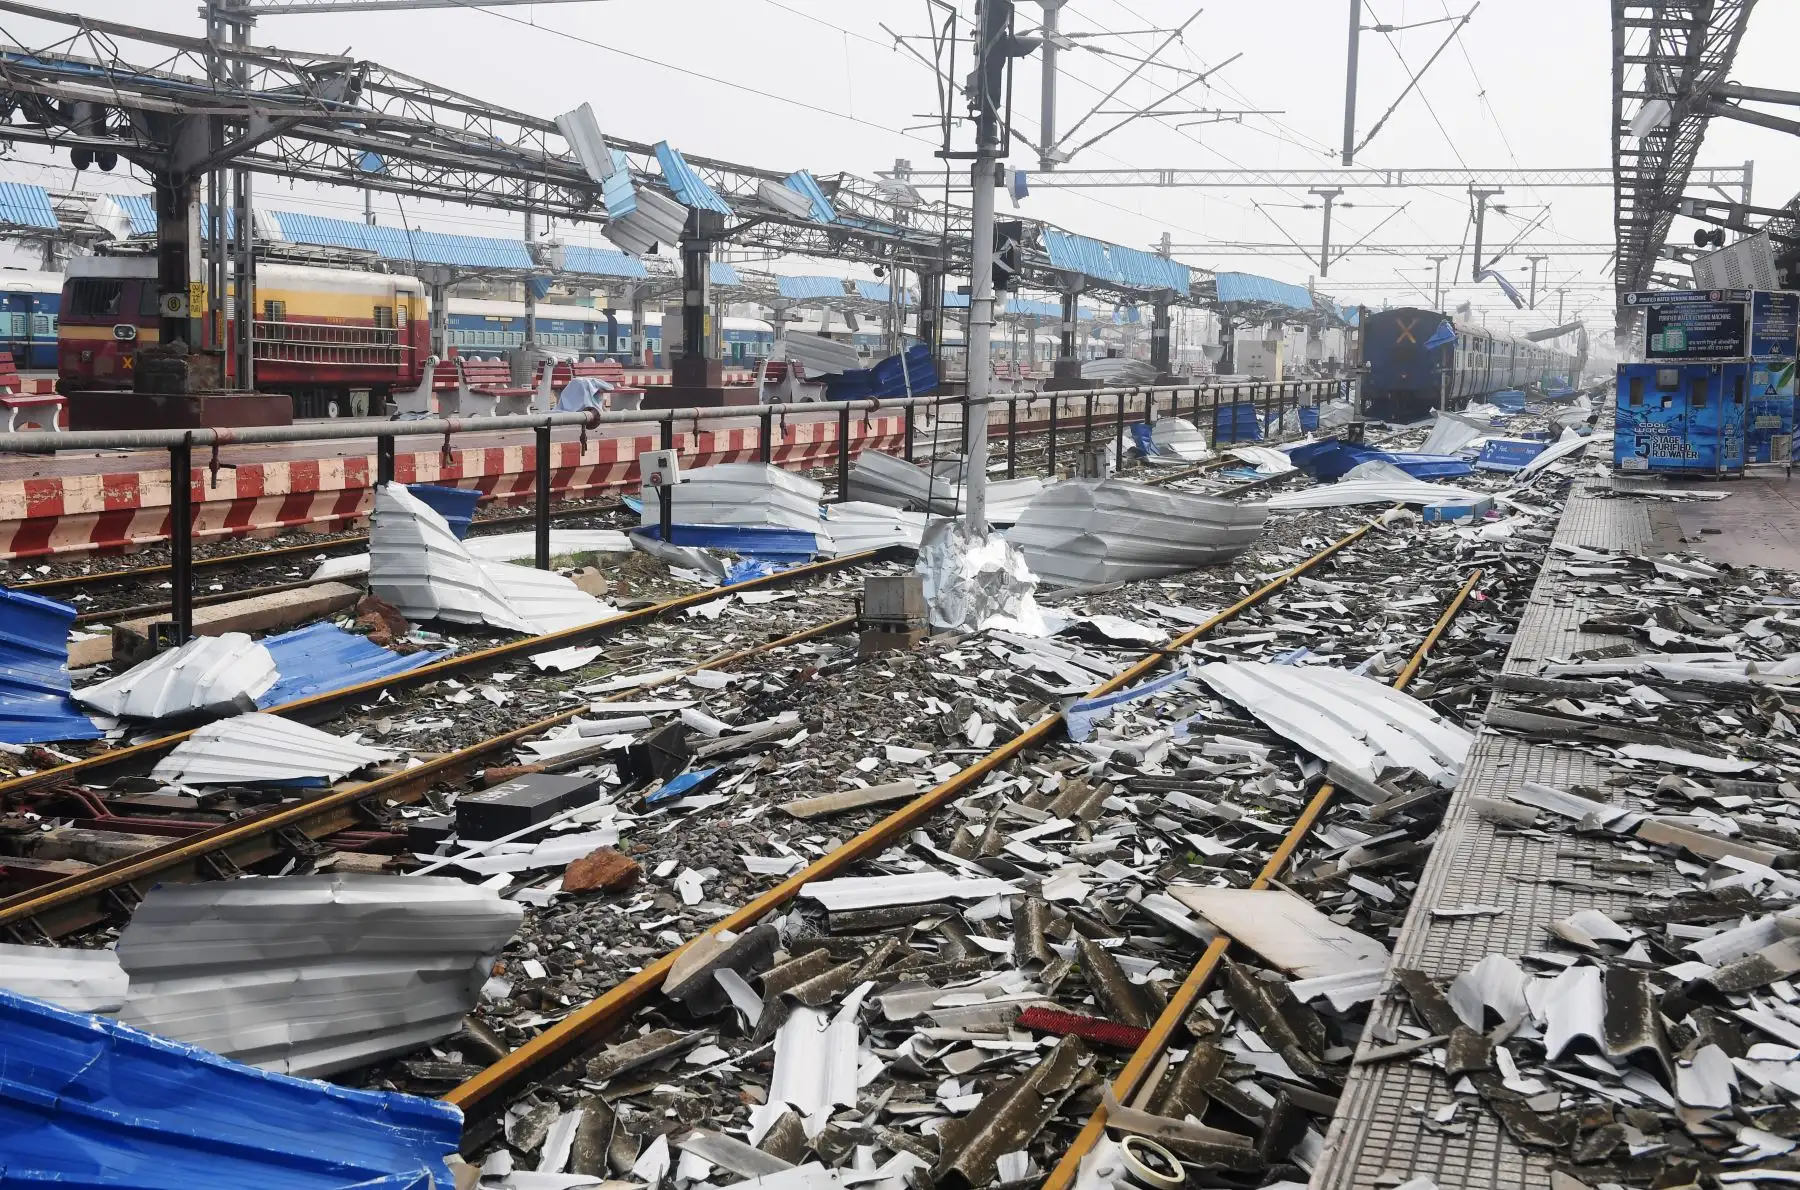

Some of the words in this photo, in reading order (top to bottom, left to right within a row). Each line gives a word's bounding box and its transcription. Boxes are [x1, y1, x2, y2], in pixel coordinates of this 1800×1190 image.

[123, 356, 133, 369] X
[1652, 435, 1680, 444] STAGE
[1634, 435, 1651, 458] 5
[1652, 443, 1691, 451] PURIFIED
[1669, 451, 1698, 459] WATER
